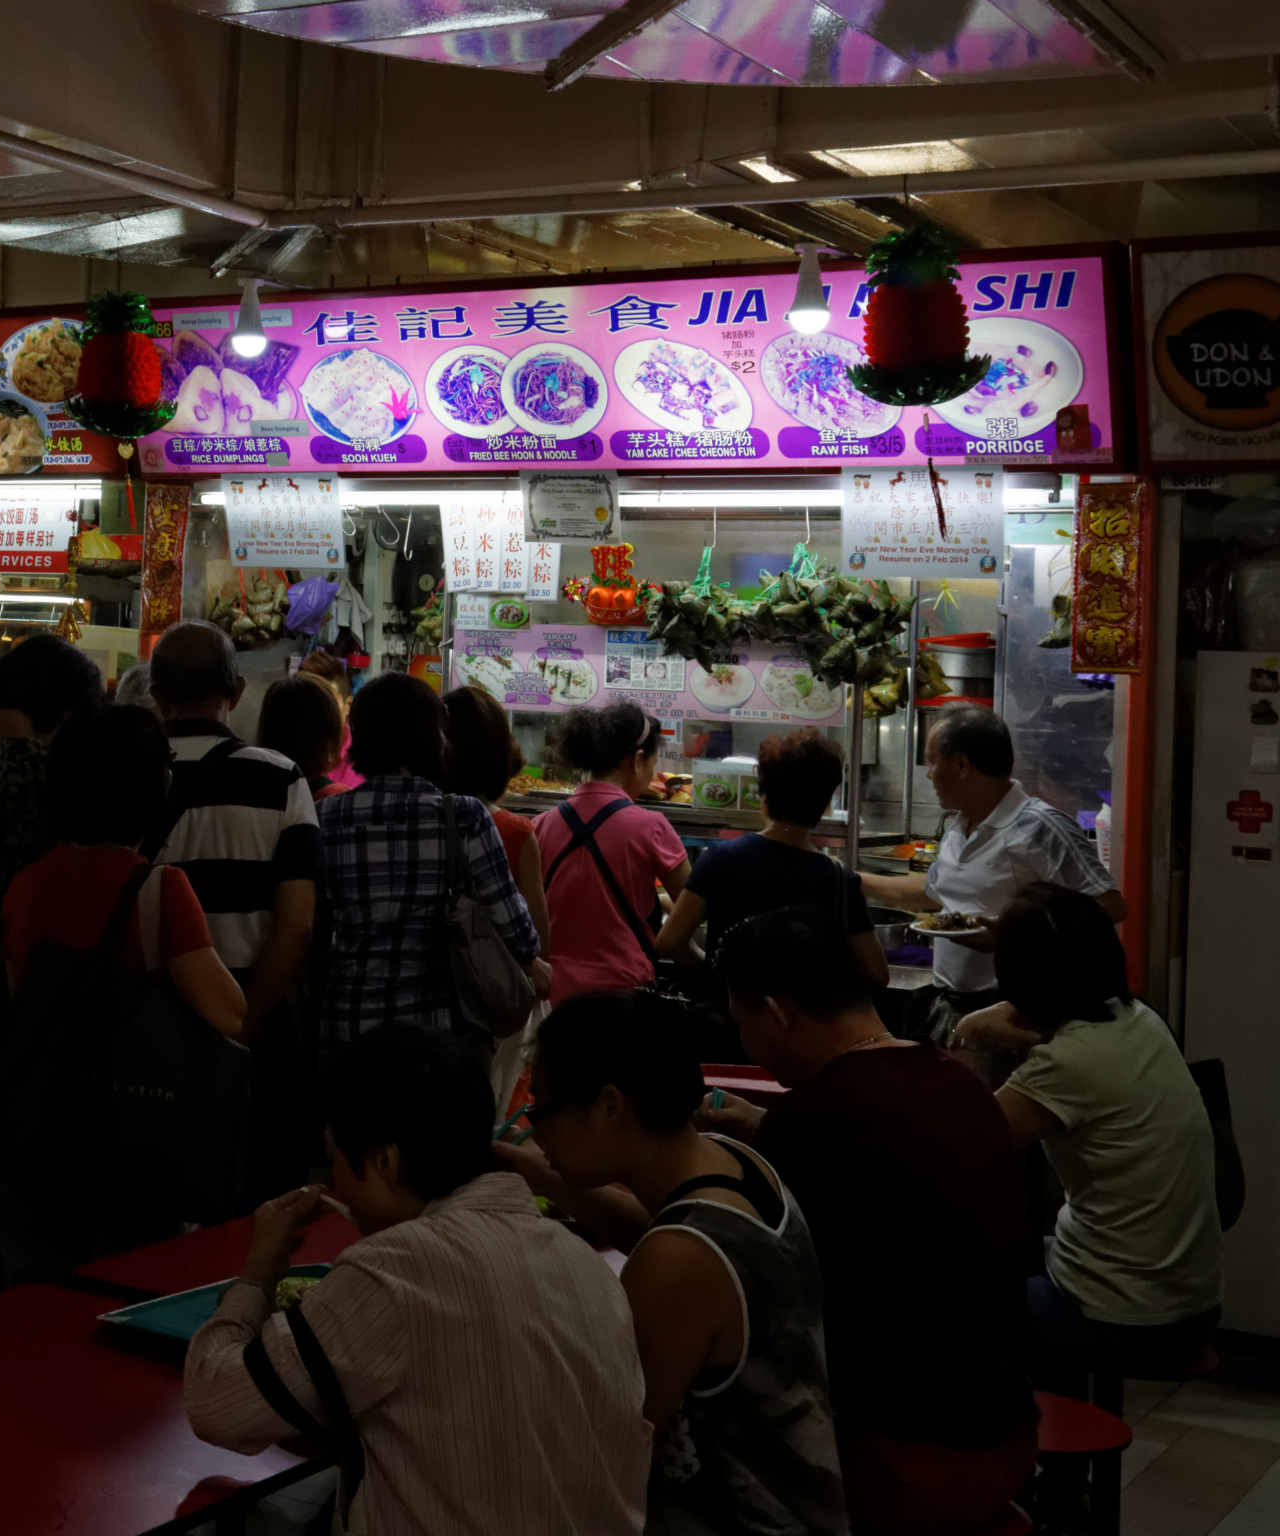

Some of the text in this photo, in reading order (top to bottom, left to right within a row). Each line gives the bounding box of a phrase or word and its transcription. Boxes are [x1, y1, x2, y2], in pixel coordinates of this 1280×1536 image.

[686, 288, 770, 327] JIA
[197, 316, 222, 326] Dumpling
[303, 294, 682, 347] 佳記美食
[731, 340, 742, 349] 加
[1189, 342, 1276, 363] DON &
[731, 360, 756, 374] $2
[1194, 366, 1272, 387] UDON
[47, 421, 79, 430] DUMPLING
[260, 424, 300, 434] Bean Dumpling
[986, 417, 1019, 439] 粥
[626, 428, 754, 449] 芋头糕/猪肠粉
[818, 427, 860, 444] 鱼生
[1186, 428, 1261, 446] NO PORK NO
[44, 436, 83, 453] 水饺汤
[486, 434, 557, 450] 炒米粉面
[578, 439, 597, 454] $1
[870, 435, 903, 454] $3/5
[965, 439, 1045, 454] PORRIDGE
[469, 449, 578, 461] FRIED BEE HOON & NOODLE
[626, 446, 756, 458] YAM CAKE CHEE CHEONG FUN
[811, 444, 869, 456] RAW FISH
[43, 455, 91, 464] DUMPLING SOUP
[191, 453, 212, 464] RICE
[213, 453, 264, 464] DUMPLINGS
[341, 453, 397, 463] SOON KUEH
[271, 477, 285, 493] 馬
[909, 470, 928, 489] 馬
[261, 507, 307, 519] 除夕早市
[250, 520, 320, 532] 開市正月初三
[238, 540, 255, 548] Lunar
[256, 540, 269, 548] New
[270, 540, 283, 548] Year
[296, 541, 320, 549] Morning
[320, 541, 335, 549] Only
[855, 545, 878, 553] Lunar
[879, 545, 898, 553] New
[899, 545, 918, 553] Year
[936, 546, 970, 556] Morning
[971, 546, 991, 556] Only
[149, 497, 180, 625] 生意隆
[878, 555, 911, 563] Resume
[925, 555, 931, 563] 2
[932, 555, 948, 563] Feb
[949, 555, 969, 563] 2014
[453, 578, 471, 588] $2.00
[502, 581, 522, 589] $2.00
[1083, 502, 1132, 665] 招財進寶
[531, 589, 551, 597] $2.50
[543, 633, 577, 642] YAM CAKE
[548, 650, 570, 658] $1.50
[517, 695, 538, 703] $2.00
[610, 691, 677, 700] SELF-SERVICE
[128, 1085, 174, 1100] KEITH
